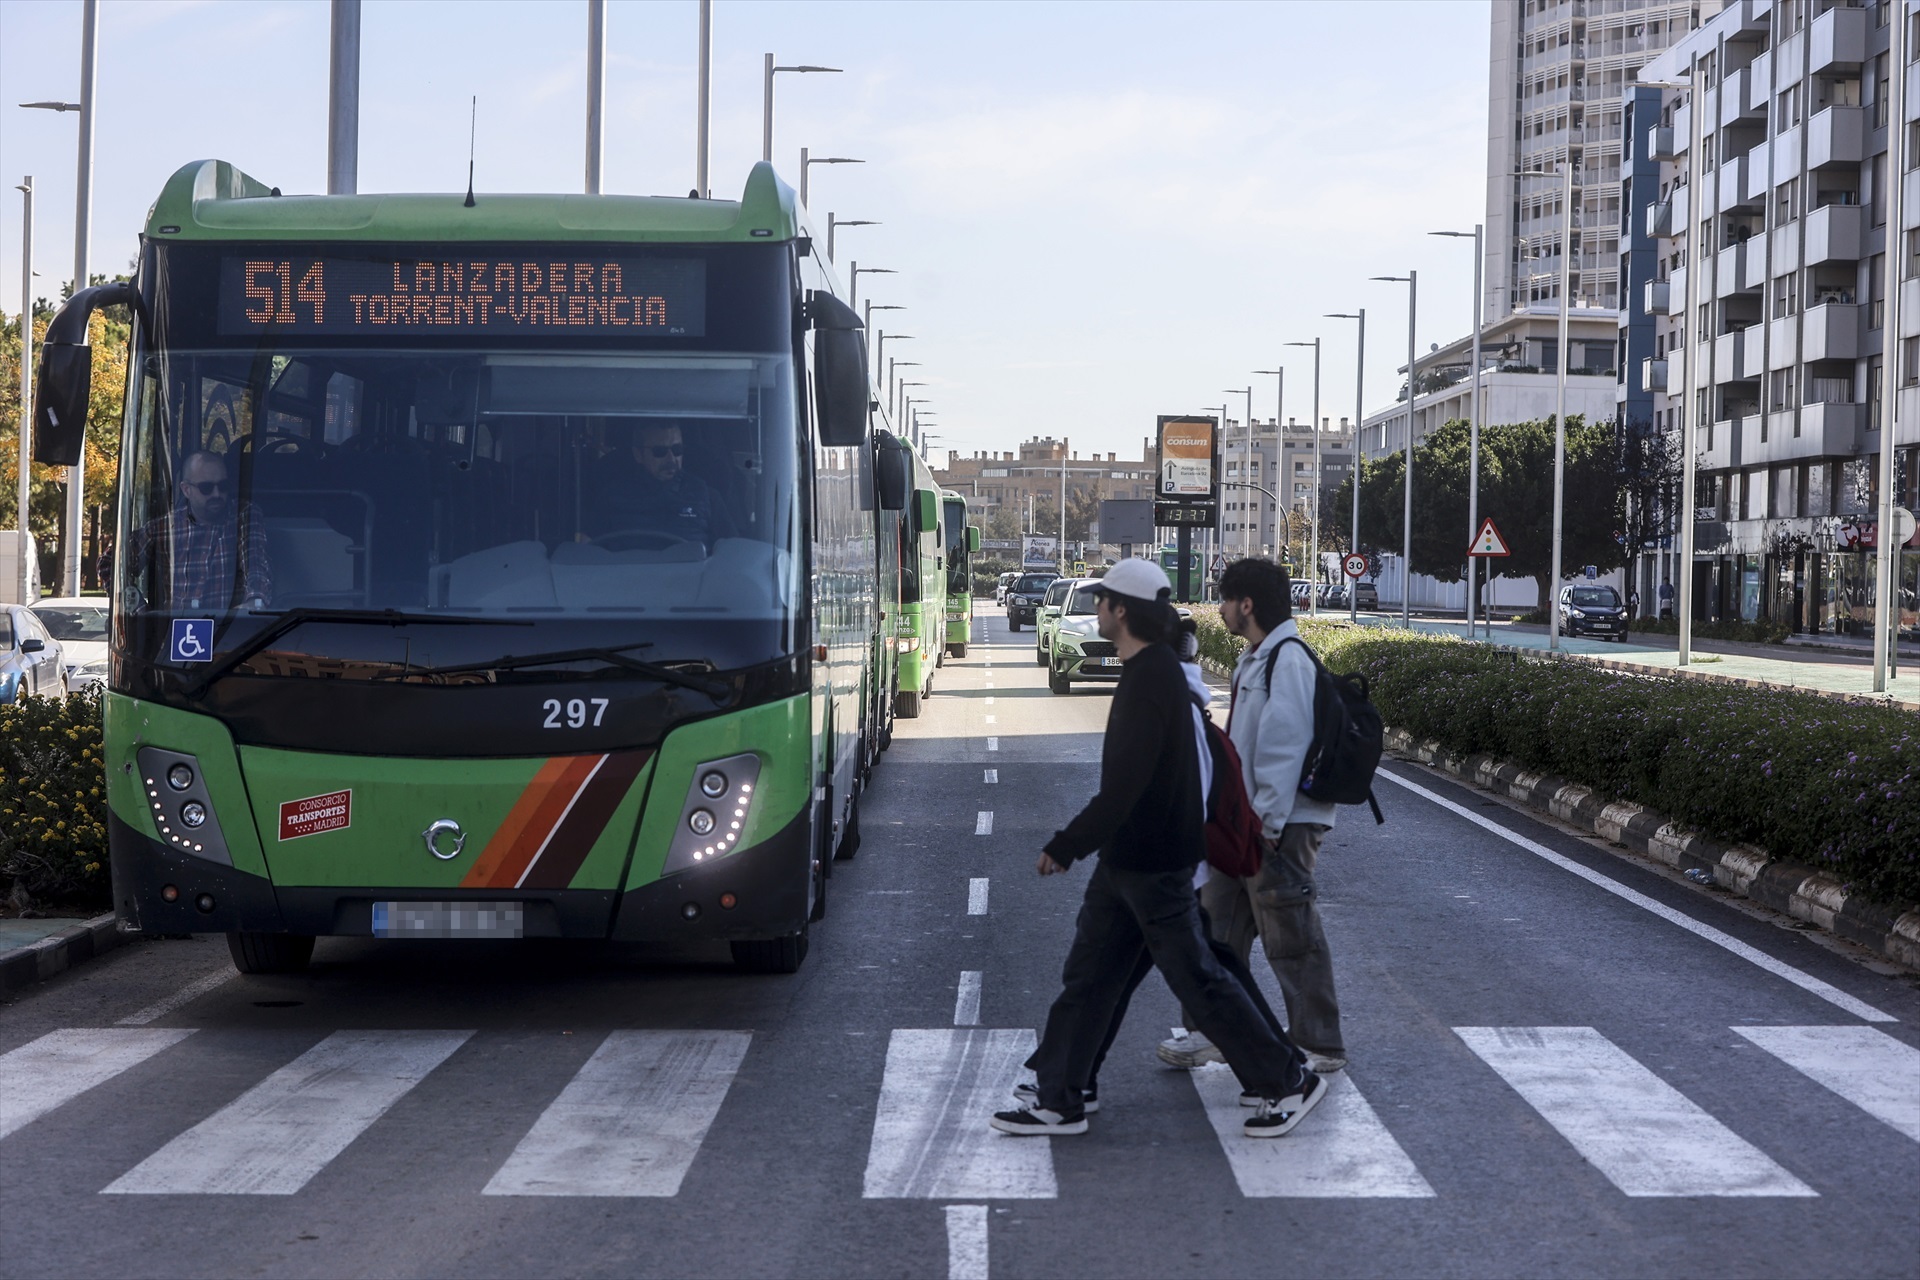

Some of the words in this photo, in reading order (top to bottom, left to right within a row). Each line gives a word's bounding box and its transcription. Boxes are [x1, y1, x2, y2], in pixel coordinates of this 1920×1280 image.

[393, 262, 623, 292] LANZADERA
[244, 261, 326, 324] 514
[350, 294, 667, 325] TORRENT-VALENCIA
[1348, 561, 1363, 570] 30
[542, 697, 609, 729] 297
[287, 805, 346, 825] TRANSPORTES
[299, 793, 347, 812] CONSORCIO
[313, 815, 346, 831] MADRID
